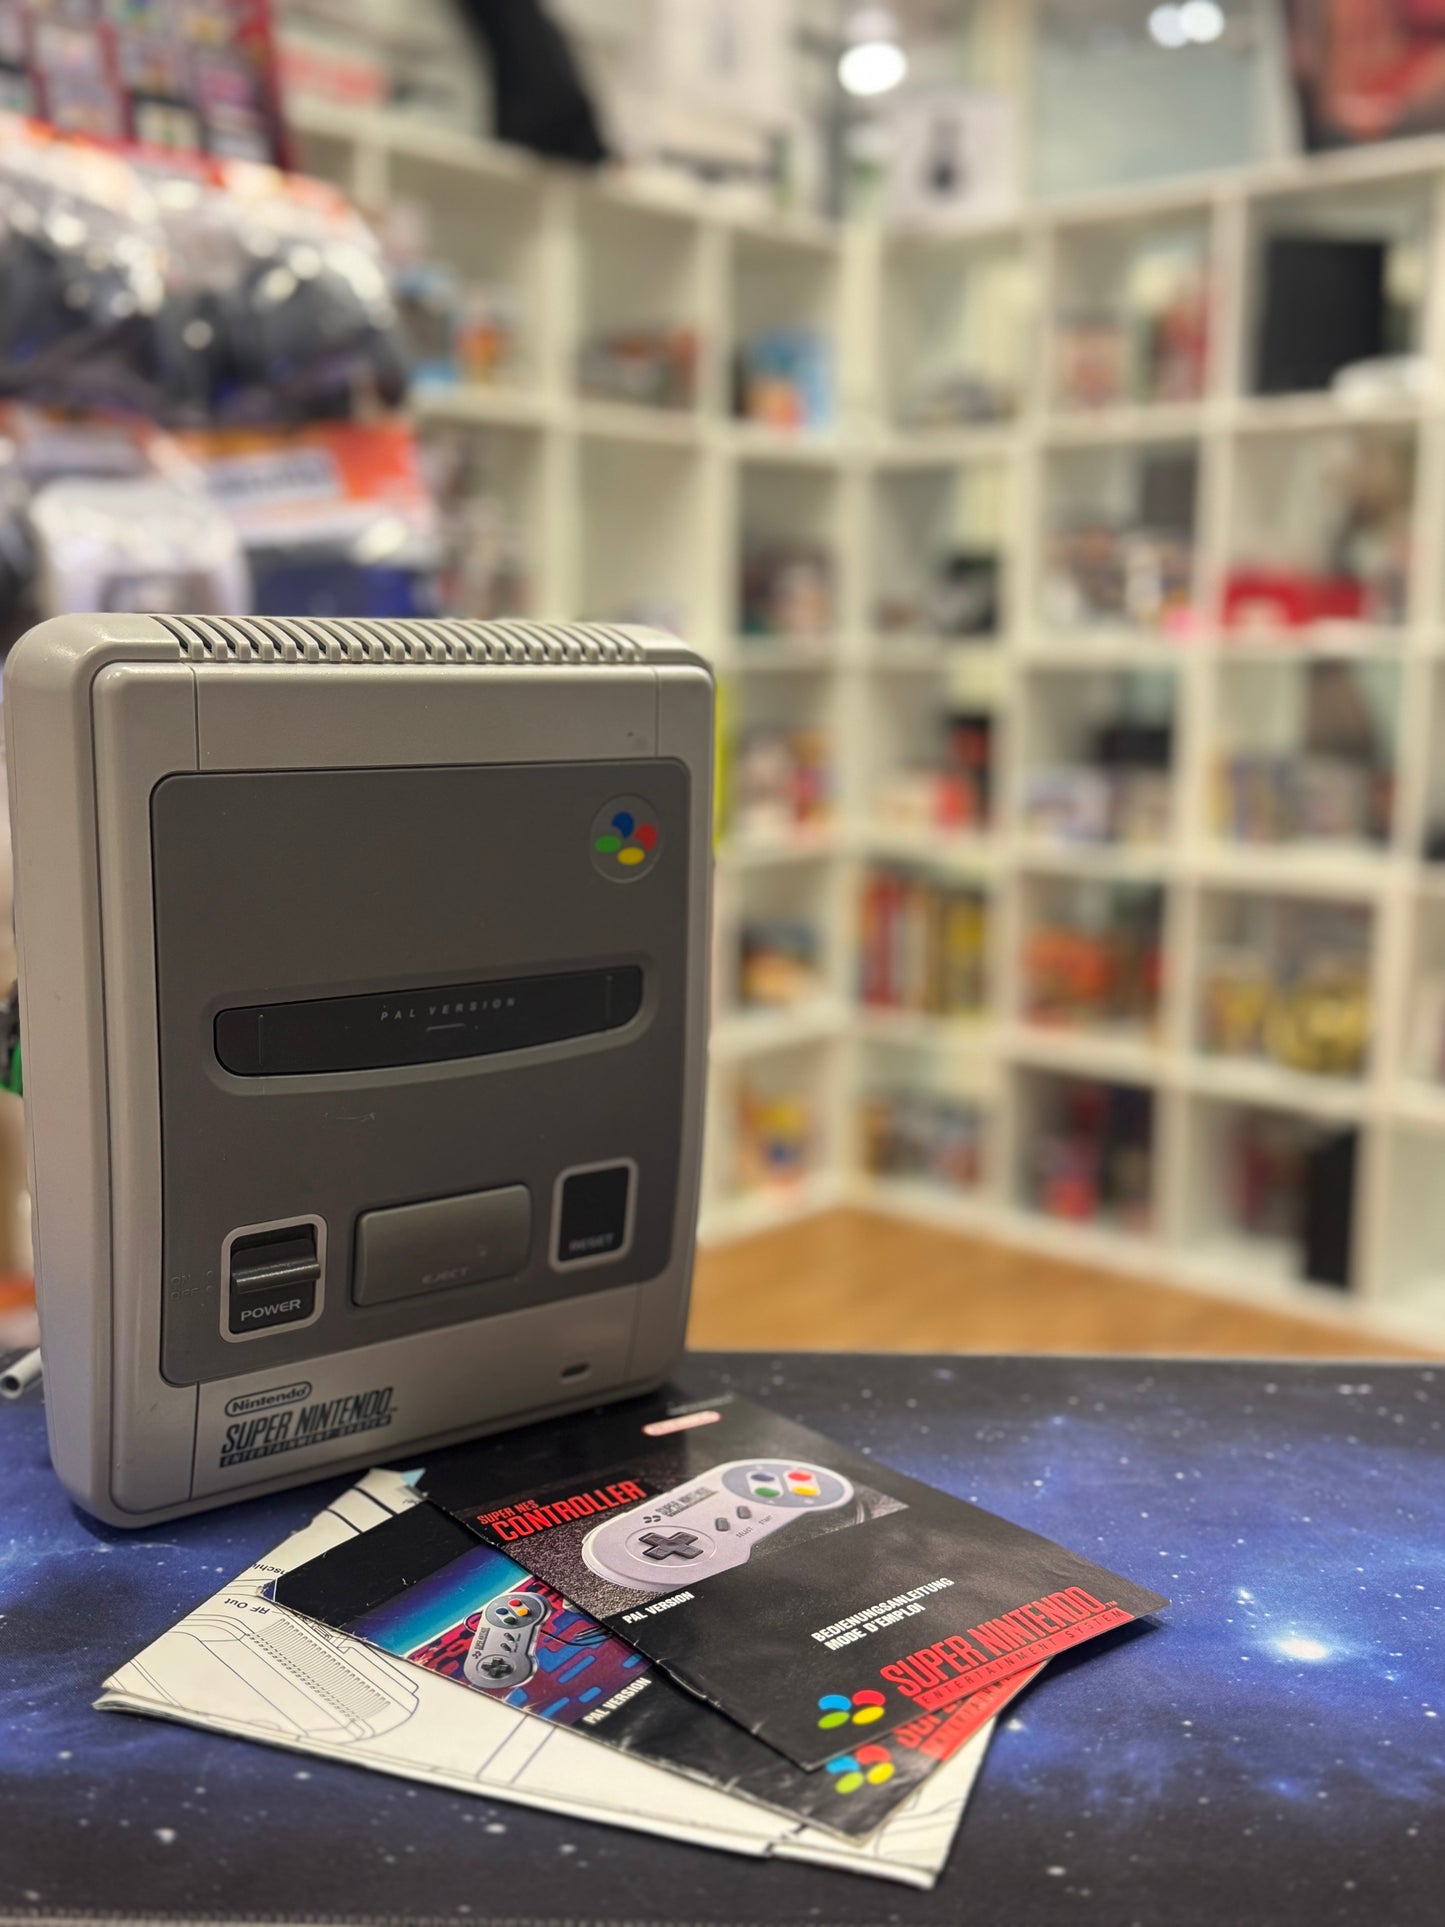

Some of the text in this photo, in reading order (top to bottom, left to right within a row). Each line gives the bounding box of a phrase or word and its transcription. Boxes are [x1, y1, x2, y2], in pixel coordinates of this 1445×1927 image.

[380, 998, 516, 1021] PAL VERSION
[240, 1299, 302, 1321] POWER
[220, 1411, 294, 1454] SUPER
[295, 1386, 394, 1437] NINTENDO
[231, 1385, 308, 1413] Nintendo
[476, 1499, 540, 1525] SUPER NES
[491, 1480, 648, 1541] CONTROLLER
[224, 1597, 271, 1615] RF Out
[621, 1591, 695, 1624] PAL VERSION
[810, 1576, 955, 1643] BEDIENUNGSANLEITUNG
[823, 1602, 927, 1651] MODE D'EMPLOI
[879, 1635, 988, 1697] SUPER
[967, 1586, 1106, 1657] NINTENDO
[920, 1609, 1124, 1704] ENTERTAINMENT SYSTEM
[582, 1676, 652, 1725] PAL VERSION
